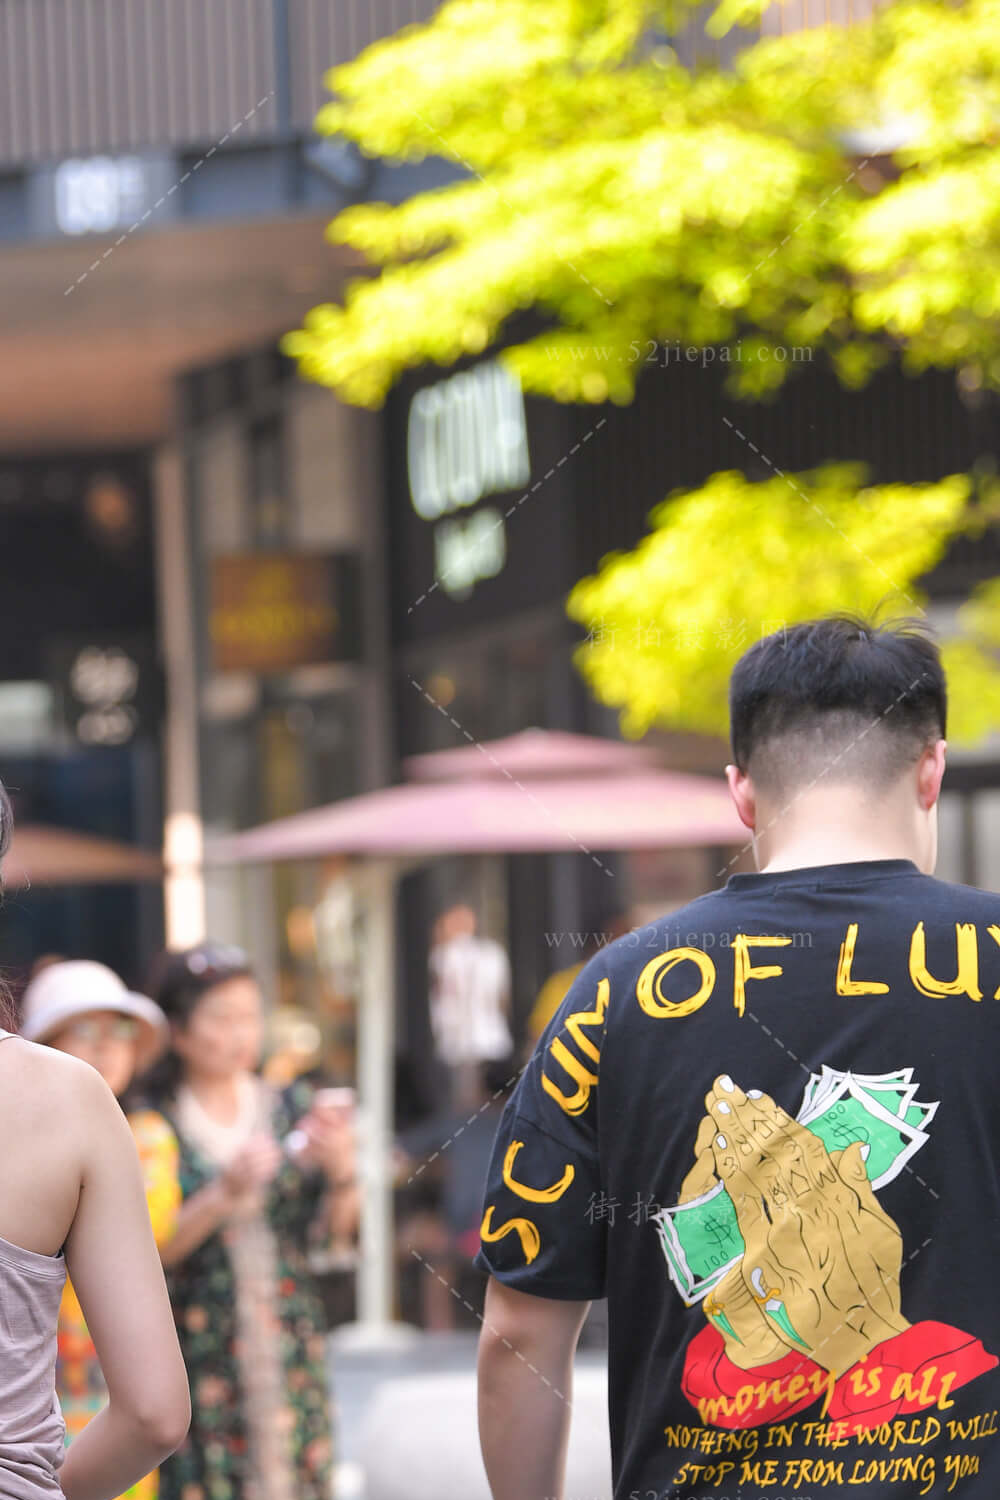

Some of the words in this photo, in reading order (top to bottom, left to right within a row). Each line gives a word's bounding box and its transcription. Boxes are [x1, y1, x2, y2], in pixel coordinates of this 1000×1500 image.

[636, 933, 793, 1019] OF
[836, 921, 1000, 1003] LU
[696, 1368, 838, 1427] money
[849, 1355, 884, 1397] is
[890, 1366, 957, 1411] all
[664, 1424, 760, 1460] NOTHING
[764, 1421, 799, 1448] IN
[802, 1421, 850, 1451] THE
[853, 1416, 942, 1452] WORLD
[946, 1410, 999, 1441] WILL
[672, 1461, 735, 1488] STOP
[738, 1459, 779, 1489] ME
[781, 1458, 845, 1490] FROM
[848, 1453, 937, 1496] LOVING
